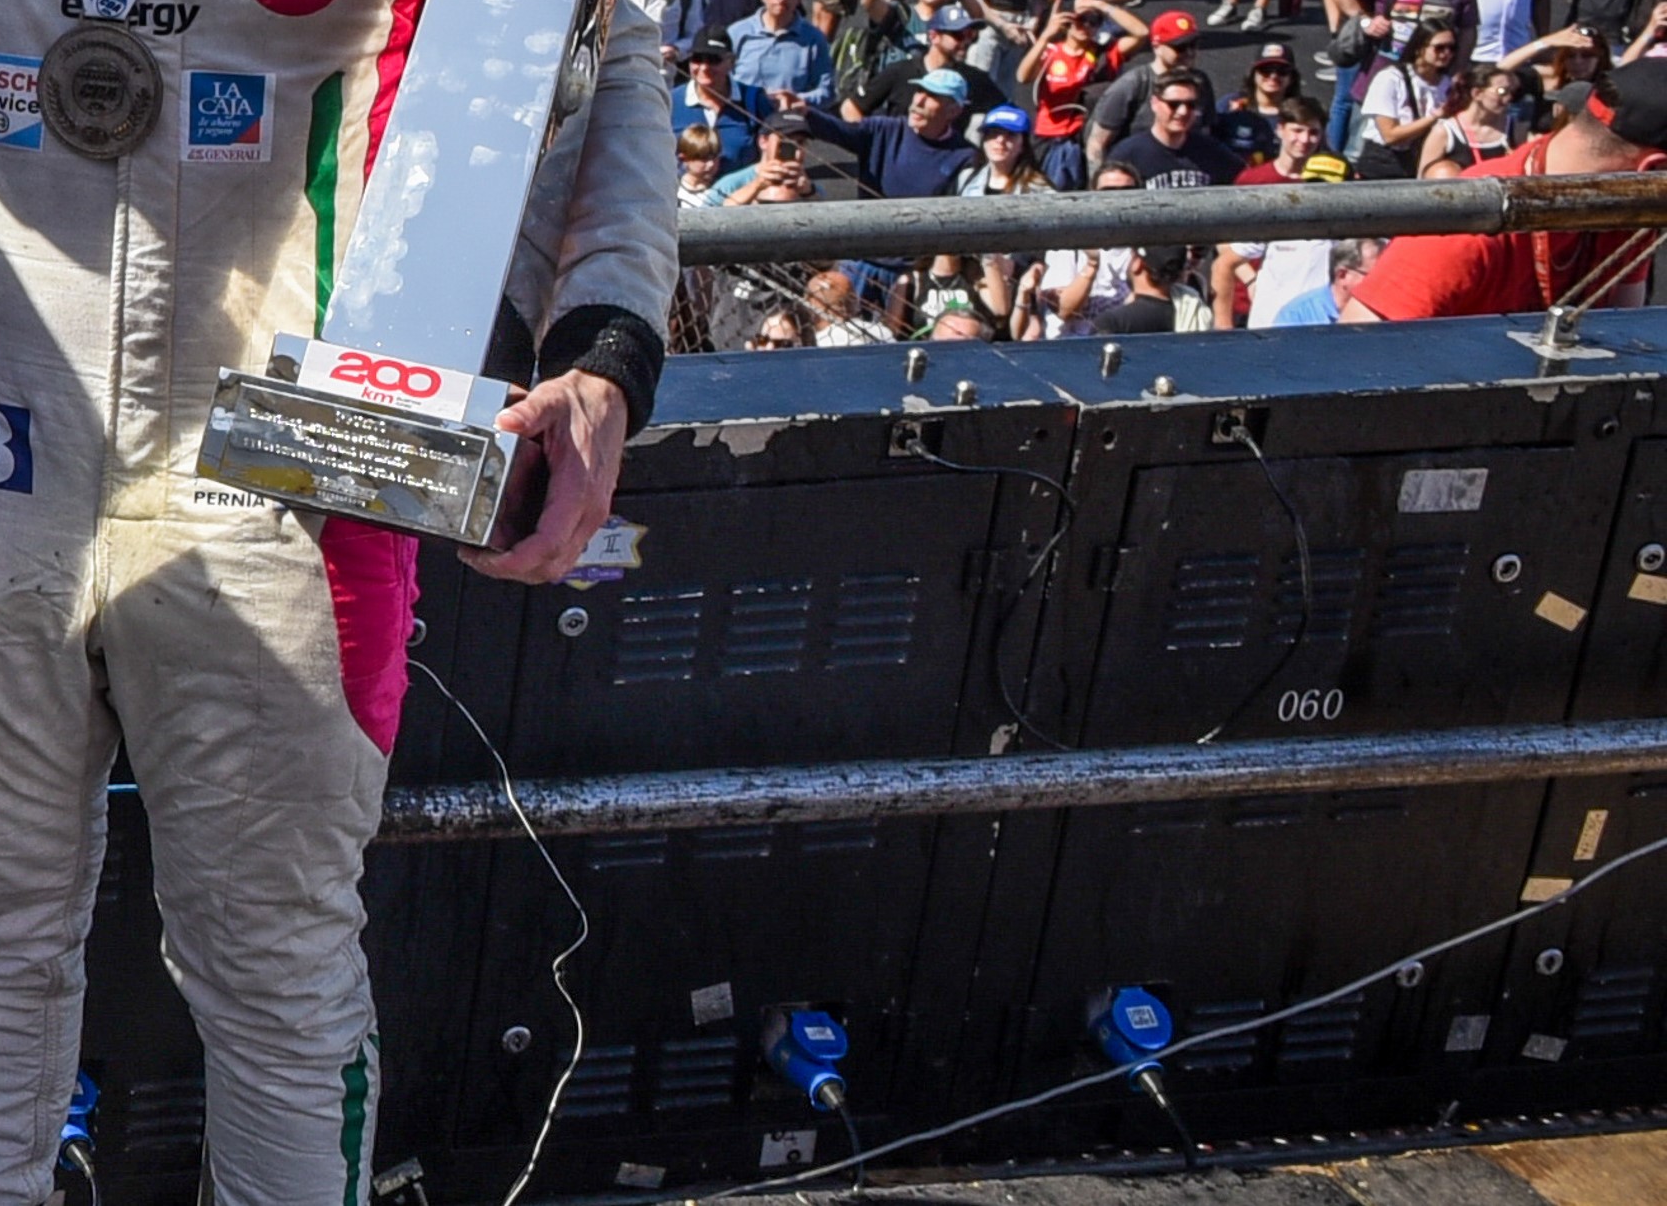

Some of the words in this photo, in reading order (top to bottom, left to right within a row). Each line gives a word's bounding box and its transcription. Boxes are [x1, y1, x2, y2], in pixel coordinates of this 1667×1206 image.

[212, 80, 241, 99] LA
[198, 97, 254, 120] CAJA
[203, 147, 262, 162] GENERALI
[330, 352, 441, 400] 200
[361, 386, 394, 405] km
[194, 490, 266, 508] PERNIA
[1277, 688, 1343, 722] 060
